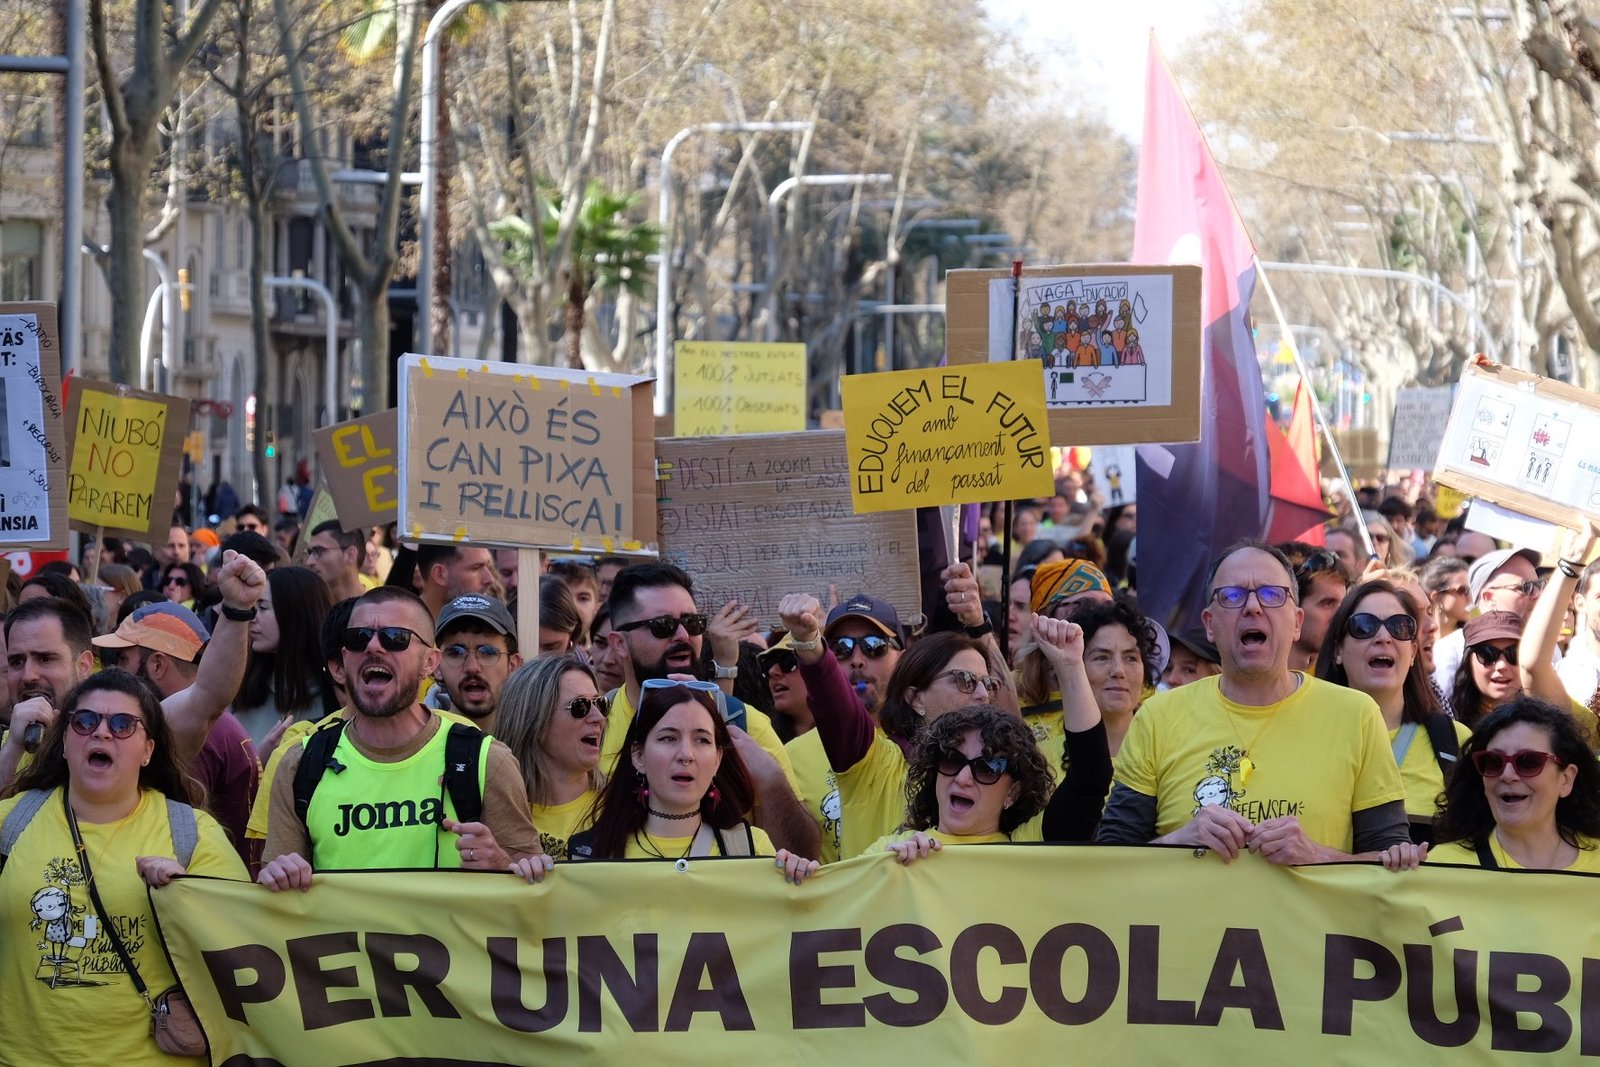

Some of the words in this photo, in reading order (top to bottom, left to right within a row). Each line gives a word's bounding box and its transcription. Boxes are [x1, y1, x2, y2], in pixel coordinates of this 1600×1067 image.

[1034, 283, 1075, 302] VAGA
[0, 327, 25, 346] ÄS
[696, 363, 738, 383] 100%
[442, 388, 530, 436] AIXÒ
[545, 395, 600, 446] ÉS
[858, 379, 933, 494] EDUQUEM
[942, 375, 975, 405] EL
[985, 391, 1045, 469] FUTUR
[922, 404, 960, 434] amb
[88, 442, 134, 478] NO
[332, 424, 392, 468] EL
[890, 430, 1008, 485] finançament
[426, 437, 501, 475] CAN
[518, 444, 613, 497] PIXA
[745, 461, 757, 478] A
[765, 456, 812, 475] 200KM
[775, 477, 793, 493] DE
[804, 473, 848, 490] CASA
[905, 467, 931, 495] del
[950, 461, 1006, 499] passat
[68, 473, 152, 520] PARAREM
[363, 465, 398, 512] E
[419, 480, 443, 511] I
[0, 515, 39, 531] NSIA
[755, 544, 781, 561] PER
[809, 542, 869, 559] LLOGUER
[889, 541, 906, 555] EL
[201, 930, 462, 1032] PER
[486, 931, 757, 1034] UNA
[789, 922, 1286, 1032] ESCOLA
